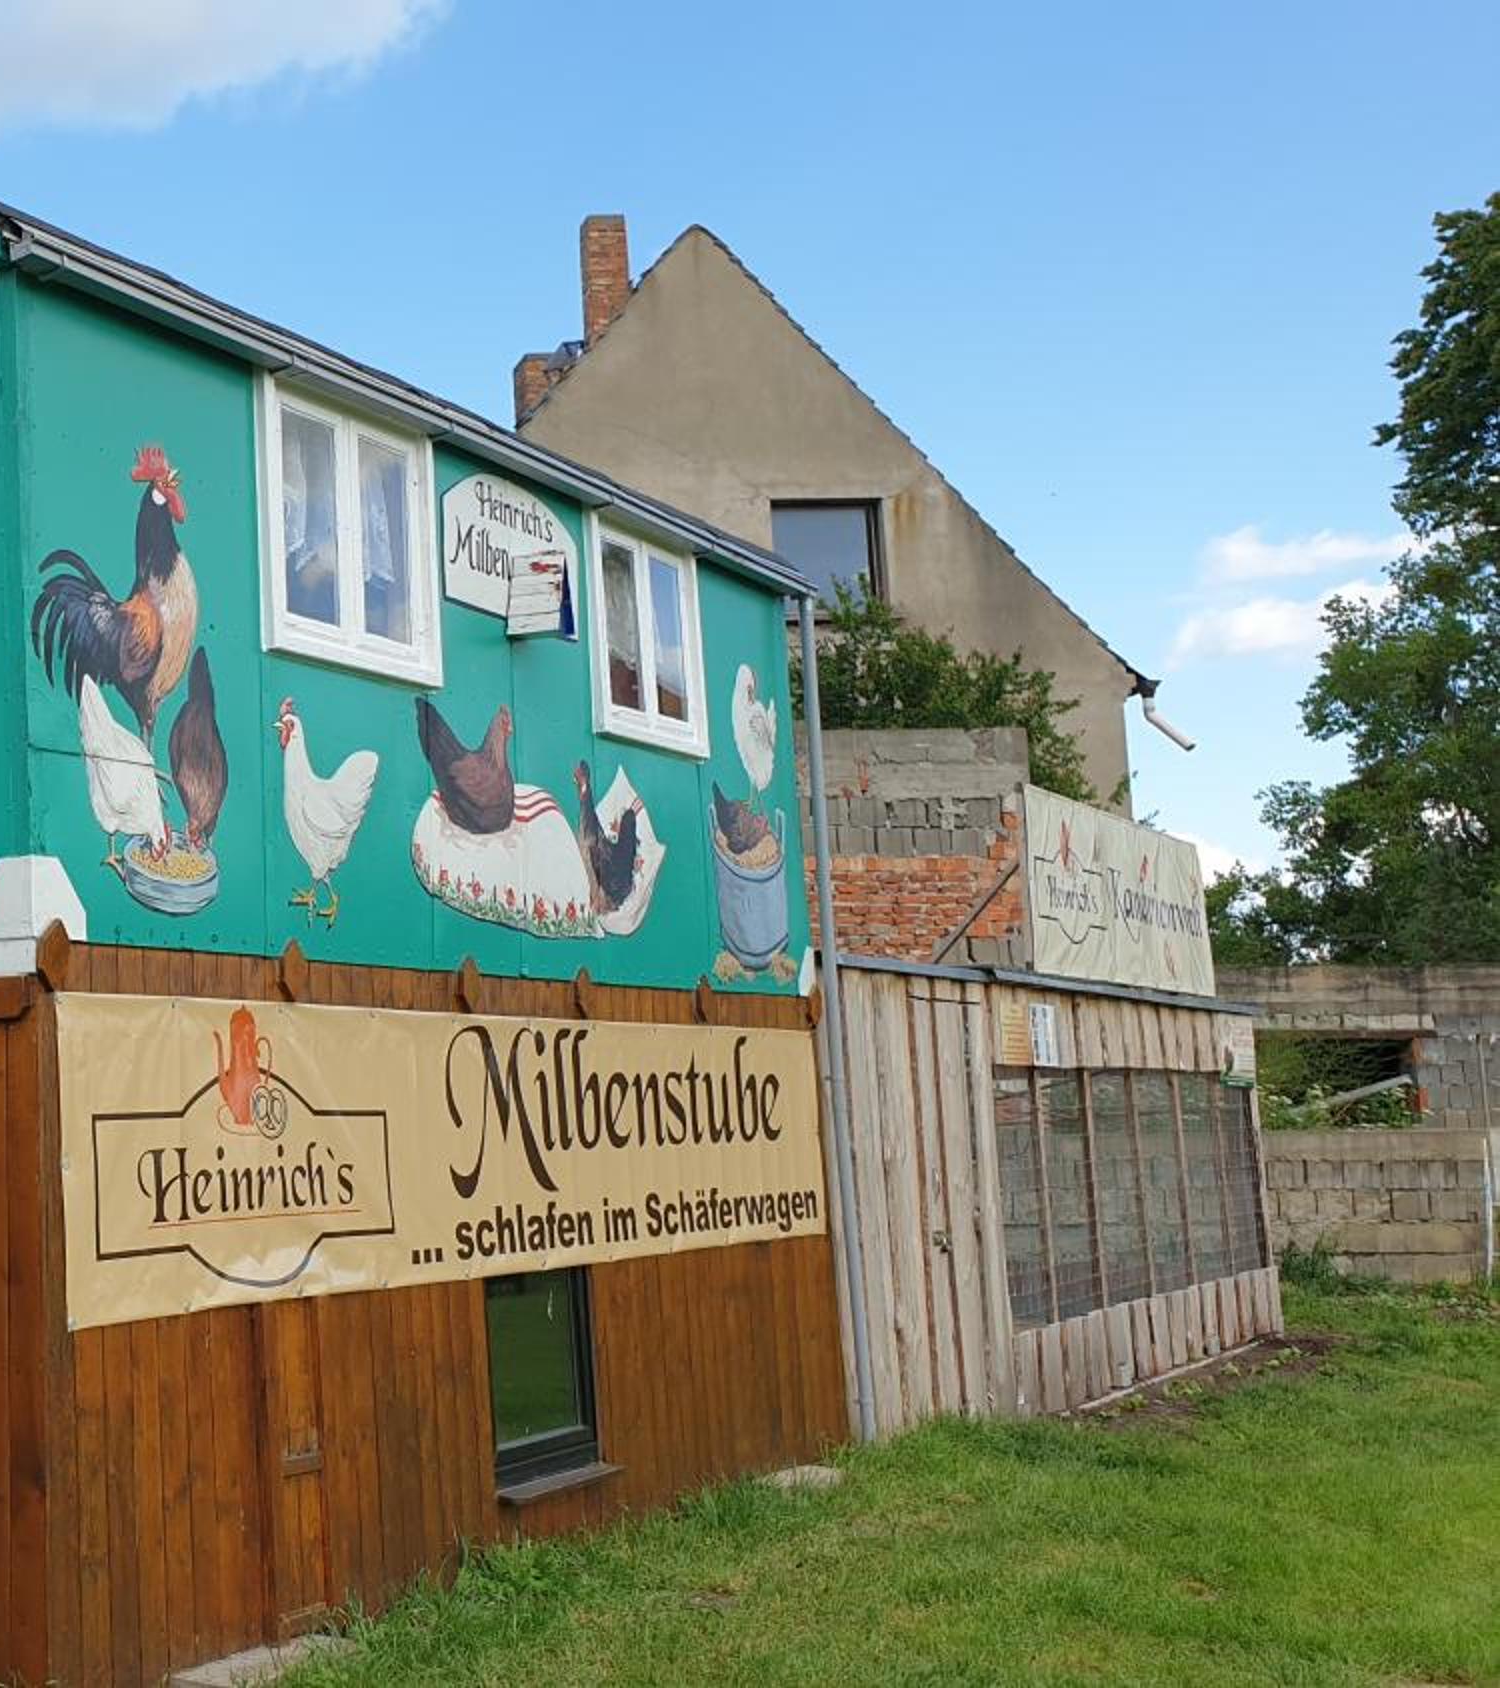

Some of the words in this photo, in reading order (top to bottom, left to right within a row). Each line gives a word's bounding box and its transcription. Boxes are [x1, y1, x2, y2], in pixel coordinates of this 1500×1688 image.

[445, 1024, 782, 1199] Milbenstube
[454, 1202, 595, 1261] schlafen
[602, 1198, 639, 1243] im
[645, 1187, 818, 1238] Schäferwagen
